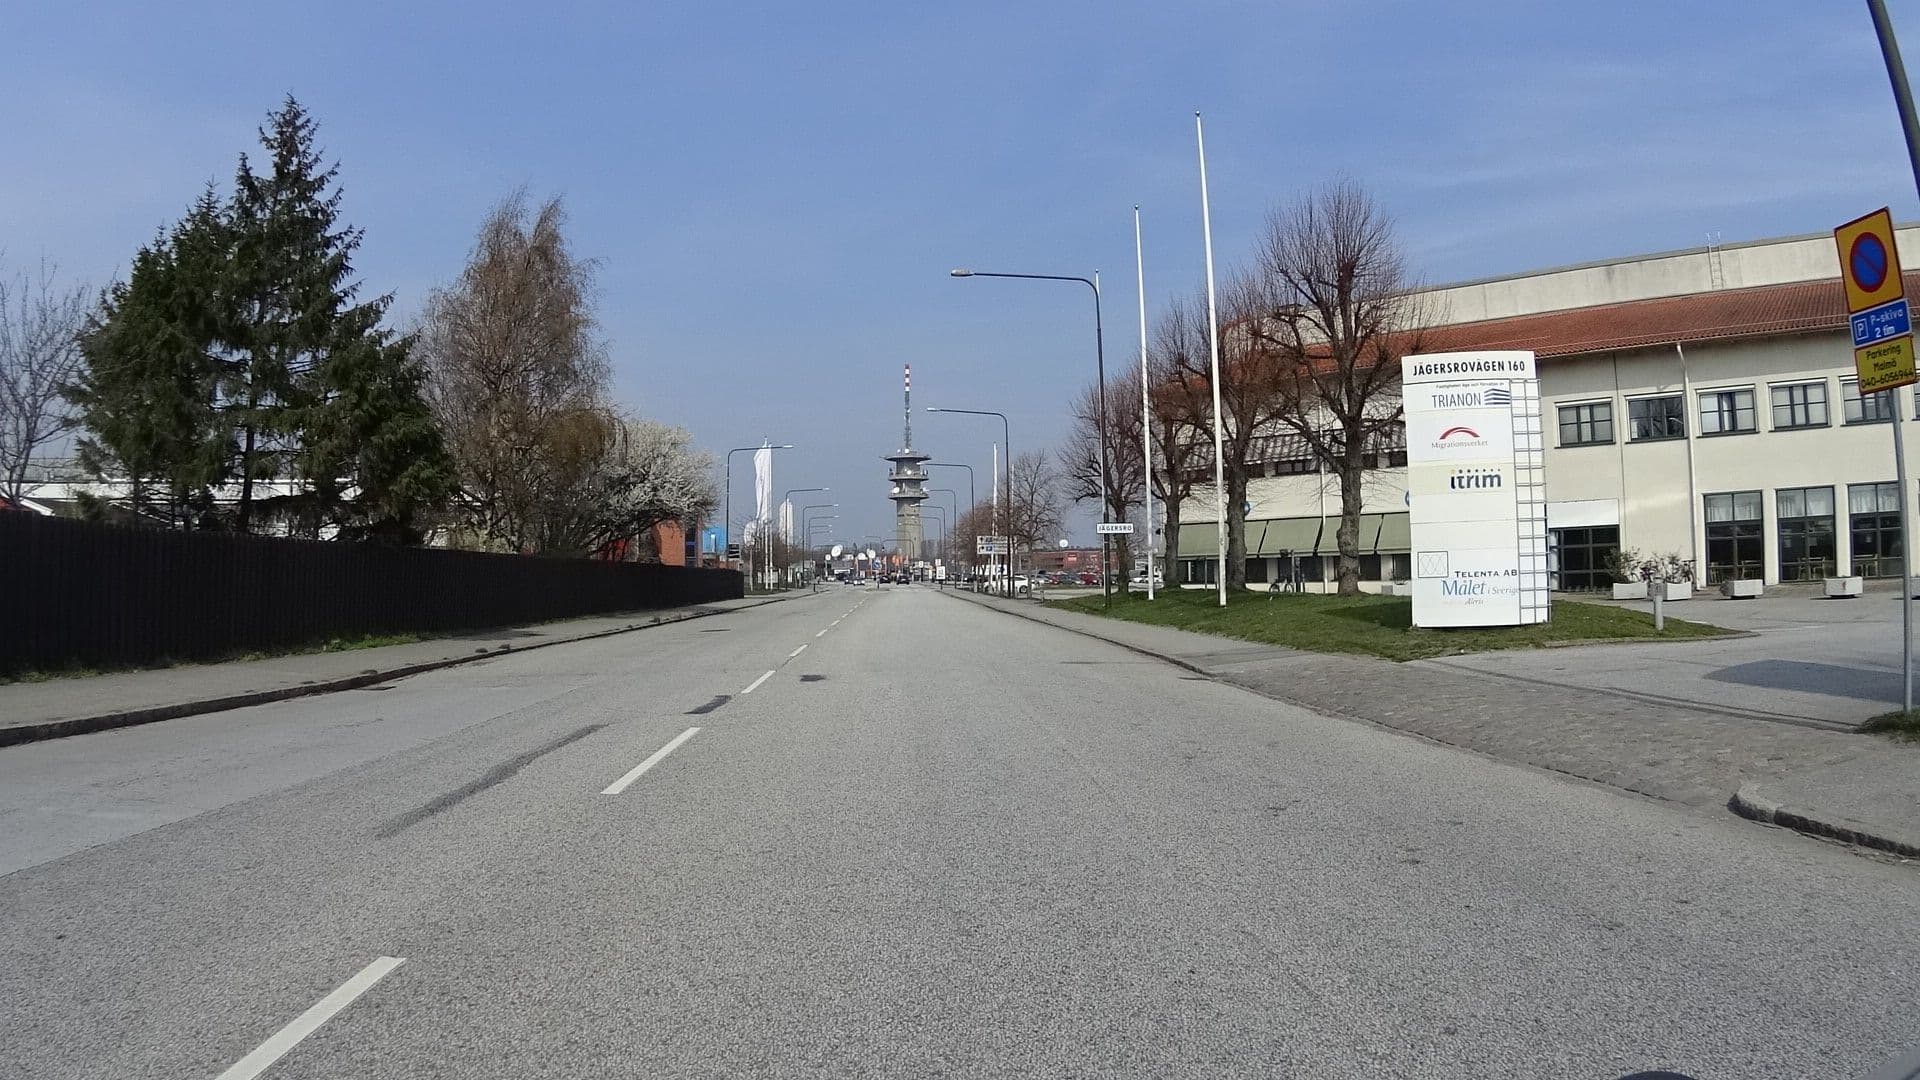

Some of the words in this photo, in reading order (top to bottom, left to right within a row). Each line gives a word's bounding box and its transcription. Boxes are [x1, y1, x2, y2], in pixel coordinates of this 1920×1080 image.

[1875, 327, 1882, 338] 2
[1866, 344, 1901, 360] Parkering
[1413, 359, 1505, 376] JÄGERSROVÄGEN
[1507, 360, 1525, 372] 160
[1432, 392, 1481, 408] TRIANON
[1431, 439, 1488, 449] Migrationsverket
[1450, 468, 1502, 490] itrim
[1454, 570, 1499, 578] TELENTA
[1503, 569, 1518, 577] AB
[1441, 580, 1487, 596] Målet
